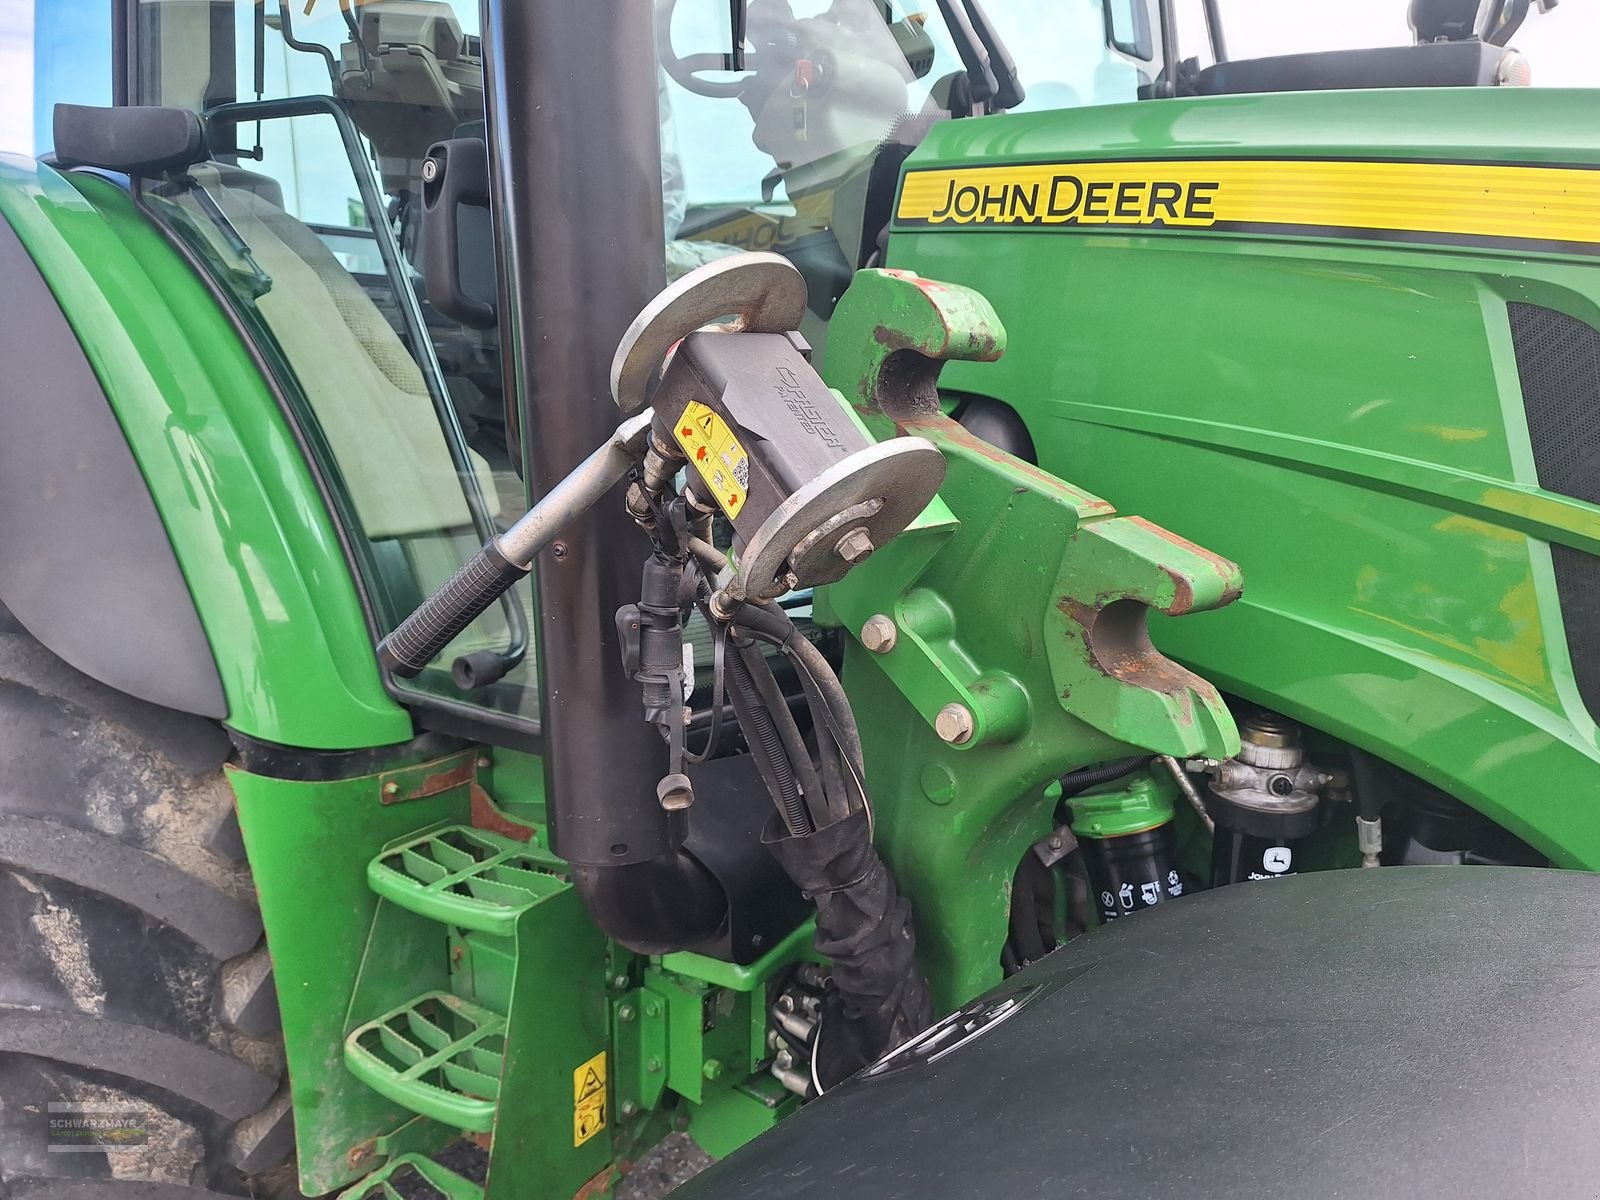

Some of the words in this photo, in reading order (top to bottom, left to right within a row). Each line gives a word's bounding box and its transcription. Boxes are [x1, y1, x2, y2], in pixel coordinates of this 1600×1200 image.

[932, 179, 1040, 218] JOHN
[1046, 175, 1220, 220] DEERE
[773, 385, 817, 435] PATENTED
